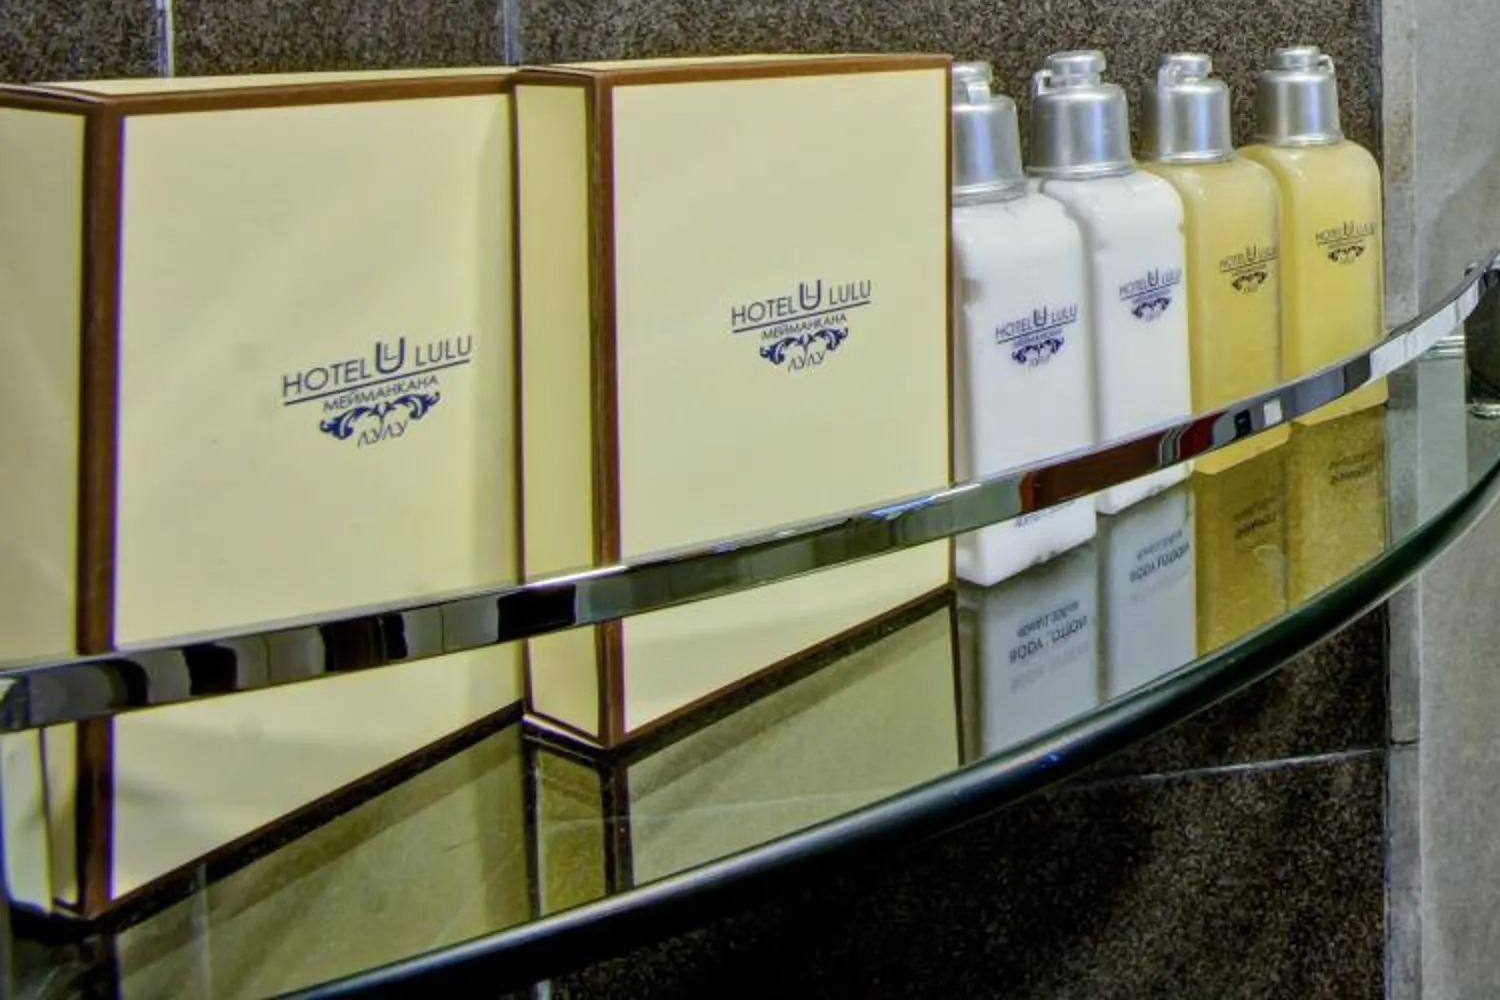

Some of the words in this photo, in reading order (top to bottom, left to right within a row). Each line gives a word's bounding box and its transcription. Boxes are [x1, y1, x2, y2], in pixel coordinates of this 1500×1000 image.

[731, 296, 798, 327] HOTEL
[829, 279, 872, 305] LULU
[995, 316, 1033, 340] HOTEL
[282, 357, 372, 397] HOTEL
[415, 335, 473, 367] LULU
